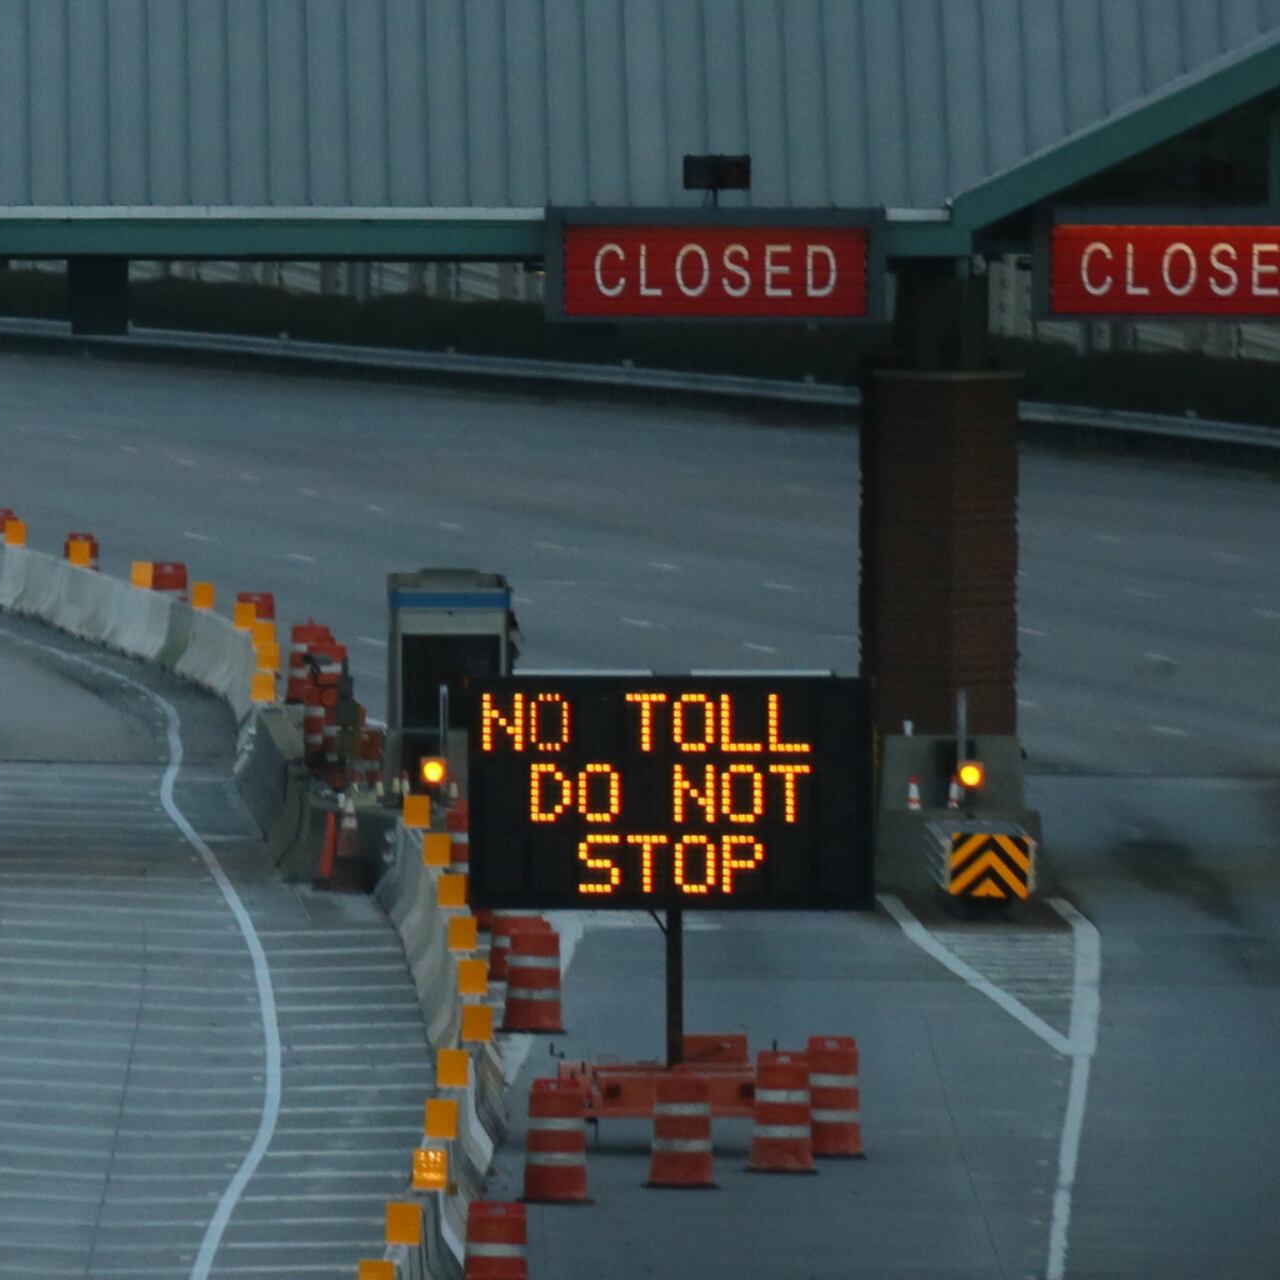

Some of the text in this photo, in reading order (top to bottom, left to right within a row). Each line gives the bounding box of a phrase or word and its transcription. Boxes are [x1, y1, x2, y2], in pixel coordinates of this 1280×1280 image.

[594, 243, 838, 297] CLOSED
[1081, 242, 1280, 296] CLOSE
[482, 693, 811, 752] NO TOLL
[531, 764, 811, 823] DO NOT
[579, 835, 764, 893] STOP
